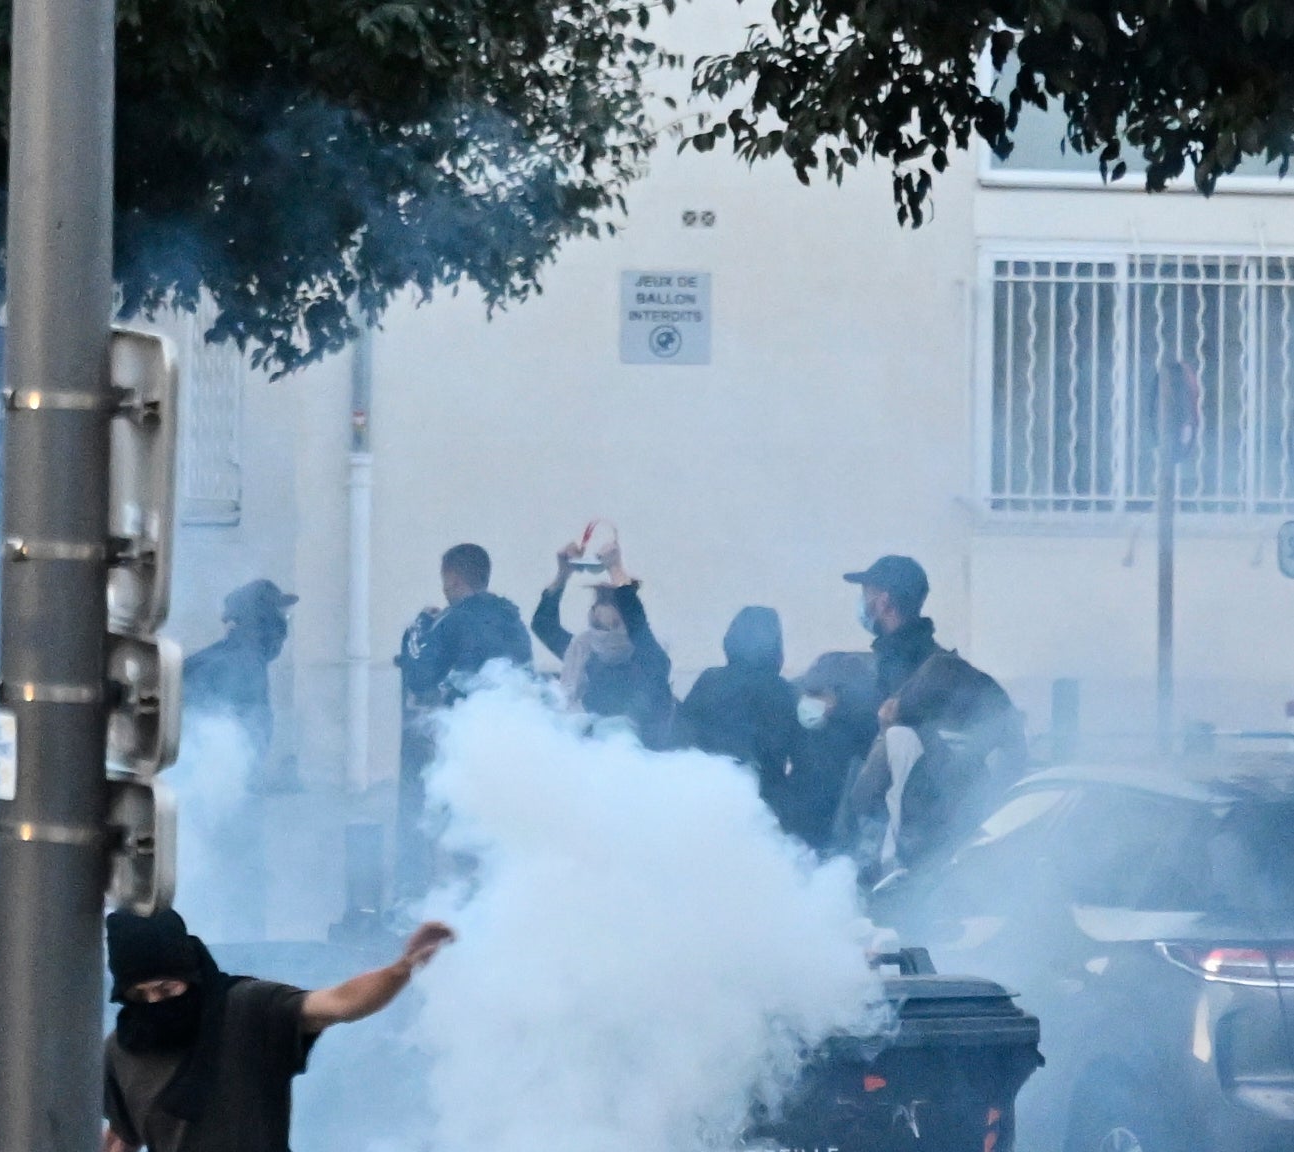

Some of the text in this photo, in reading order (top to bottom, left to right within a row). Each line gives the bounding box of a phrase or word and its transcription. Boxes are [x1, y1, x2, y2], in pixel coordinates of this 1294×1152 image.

[635, 275, 698, 288] JEUX DE
[636, 292, 696, 305] BALLON
[628, 310, 703, 322] INTERDITS
